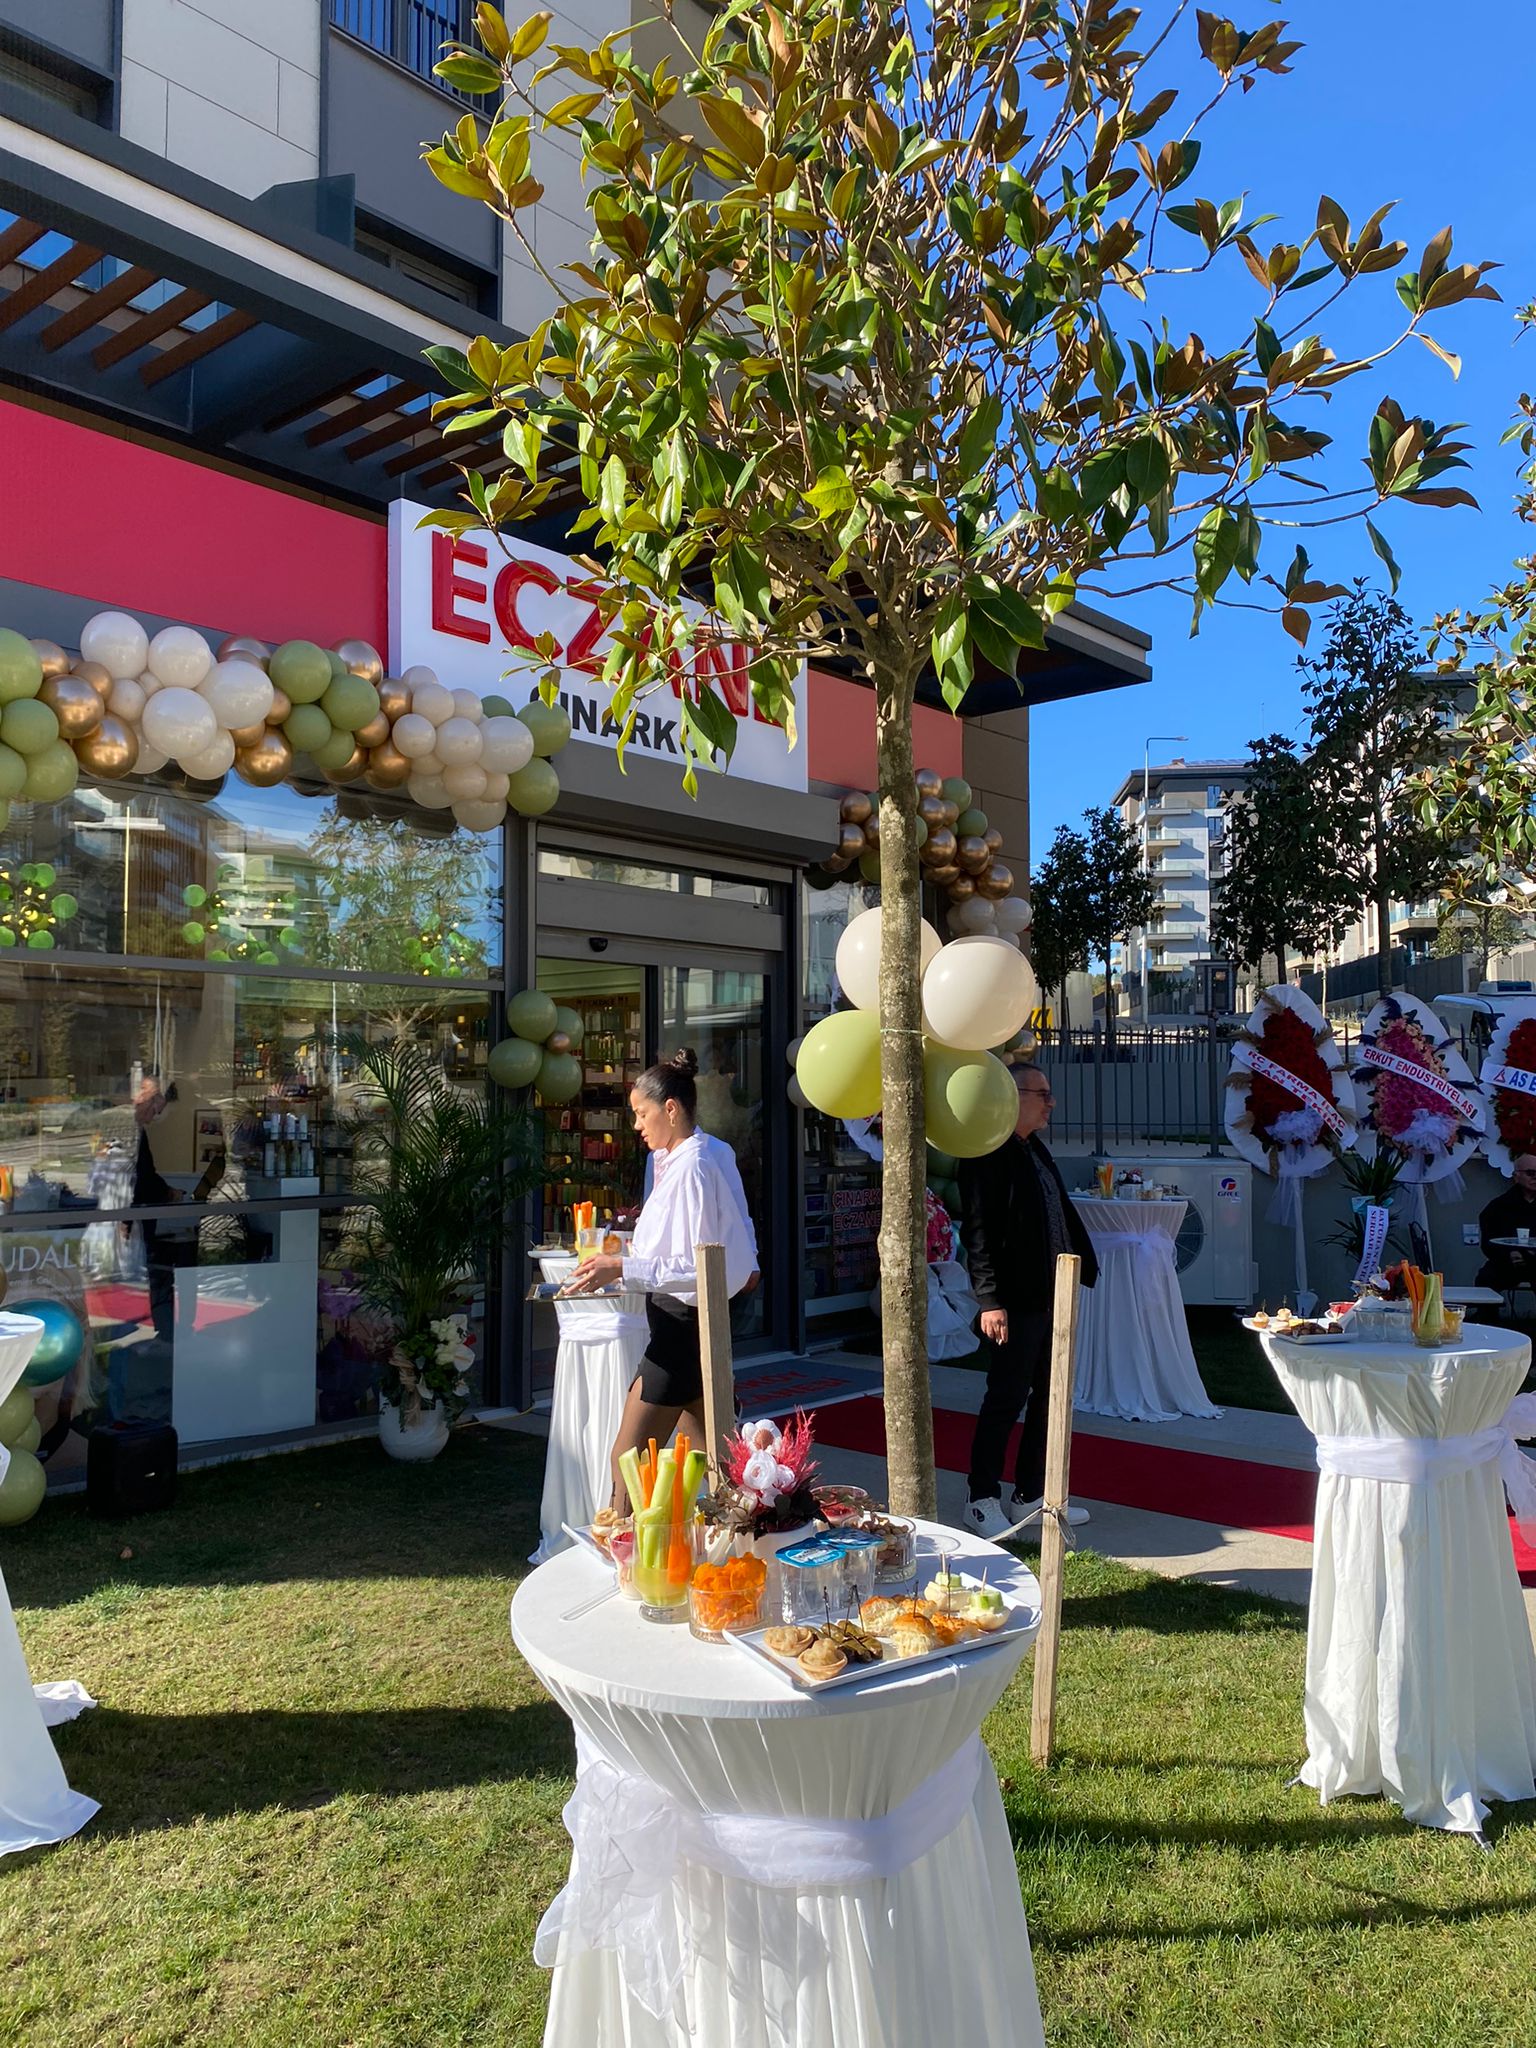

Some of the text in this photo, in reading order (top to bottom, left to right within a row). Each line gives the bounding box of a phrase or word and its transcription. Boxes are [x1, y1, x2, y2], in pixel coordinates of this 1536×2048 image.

[1363, 1048, 1395, 1067] ERKUT
[1251, 1062, 1285, 1085] CAN
[1268, 1063, 1318, 1099] FARMA
[1508, 1070, 1529, 1088] AS
